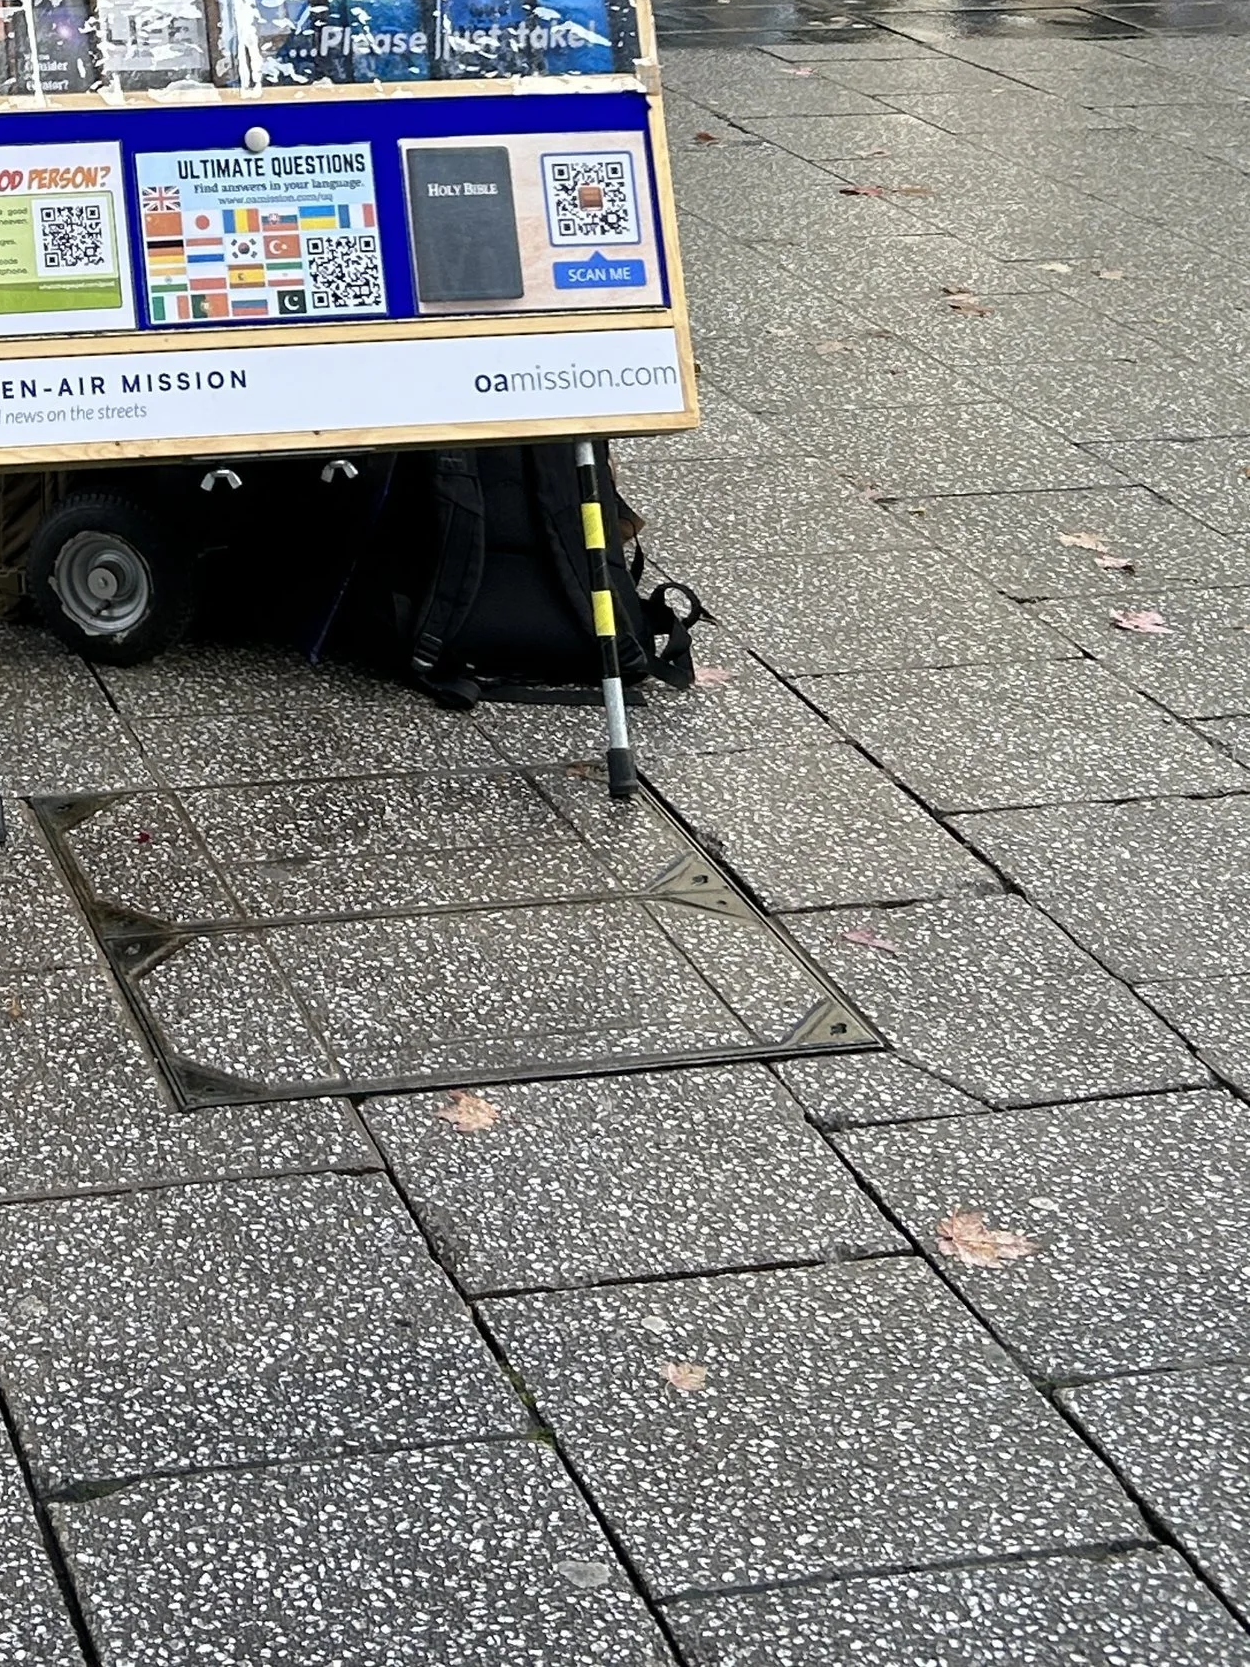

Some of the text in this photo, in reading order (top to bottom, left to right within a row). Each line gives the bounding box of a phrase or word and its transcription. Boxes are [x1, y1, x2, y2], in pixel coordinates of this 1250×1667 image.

[178, 153, 366, 180] ULTIMATE QUESTIONS
[27, 166, 111, 190] PERSON?
[194, 179, 365, 194] Find answers in your language.
[428, 183, 498, 197] HOLY BIBLE
[8, 208, 27, 216] good
[568, 267, 631, 282] SCAN ME
[121, 370, 248, 393] MISSION
[475, 363, 677, 393] oamission.com
[5, 411, 44, 424] news
[46, 409, 66, 423] on
[70, 406, 94, 422] the
[97, 403, 147, 420] streets
